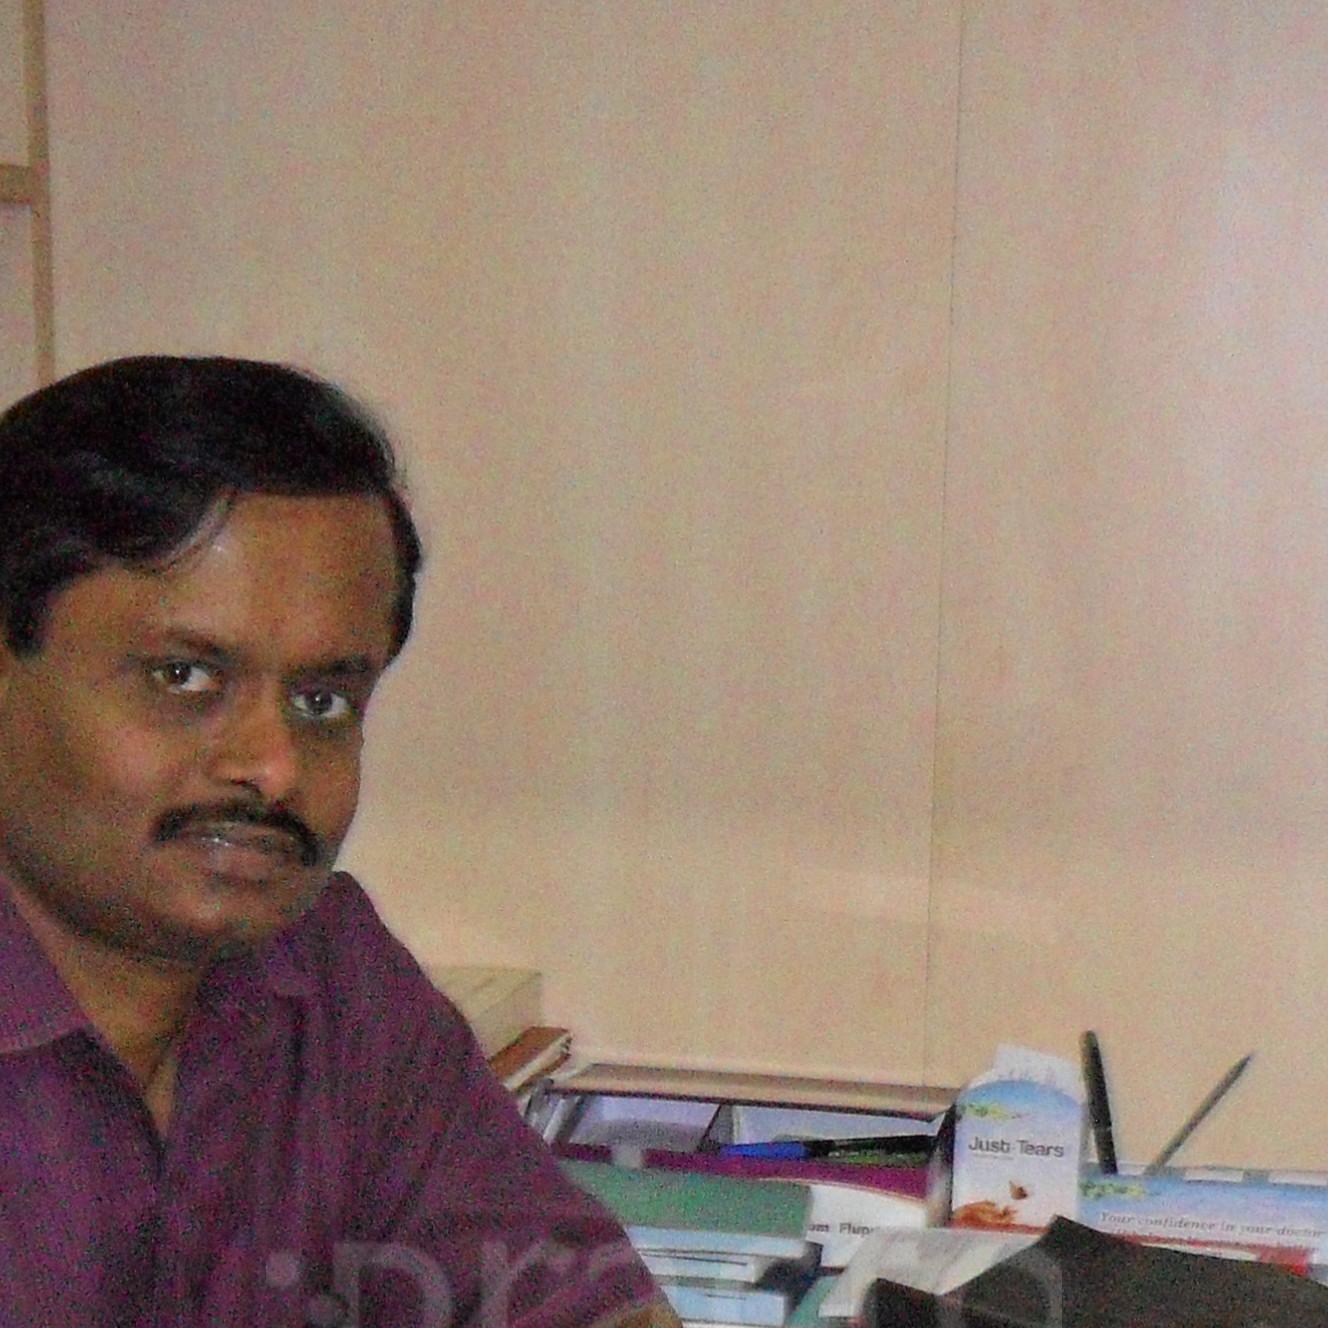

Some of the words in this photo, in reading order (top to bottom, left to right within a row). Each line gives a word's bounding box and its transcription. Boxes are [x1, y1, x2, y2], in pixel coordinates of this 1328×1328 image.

[968, 1136, 1011, 1154] Just
[1016, 1139, 1065, 1158] Tears
[1101, 1210, 1135, 1224] Your
